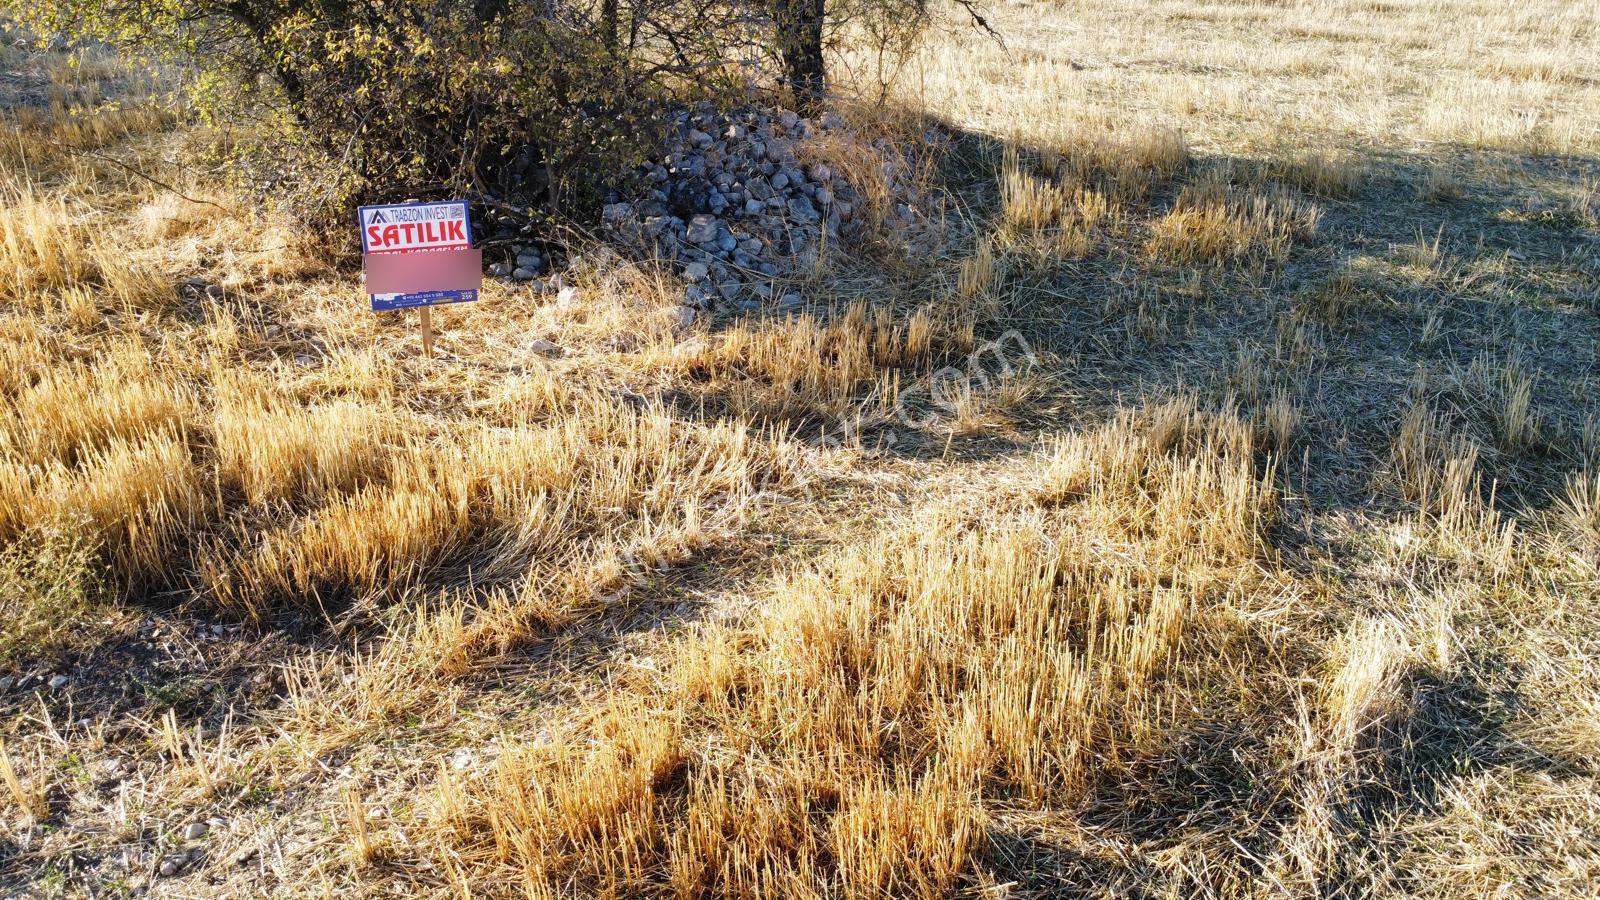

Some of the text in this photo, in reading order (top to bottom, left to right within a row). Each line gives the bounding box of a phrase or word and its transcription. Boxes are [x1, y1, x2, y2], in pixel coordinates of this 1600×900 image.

[390, 206, 449, 222] TRABZON INVEST
[367, 220, 466, 248] SATILIK
